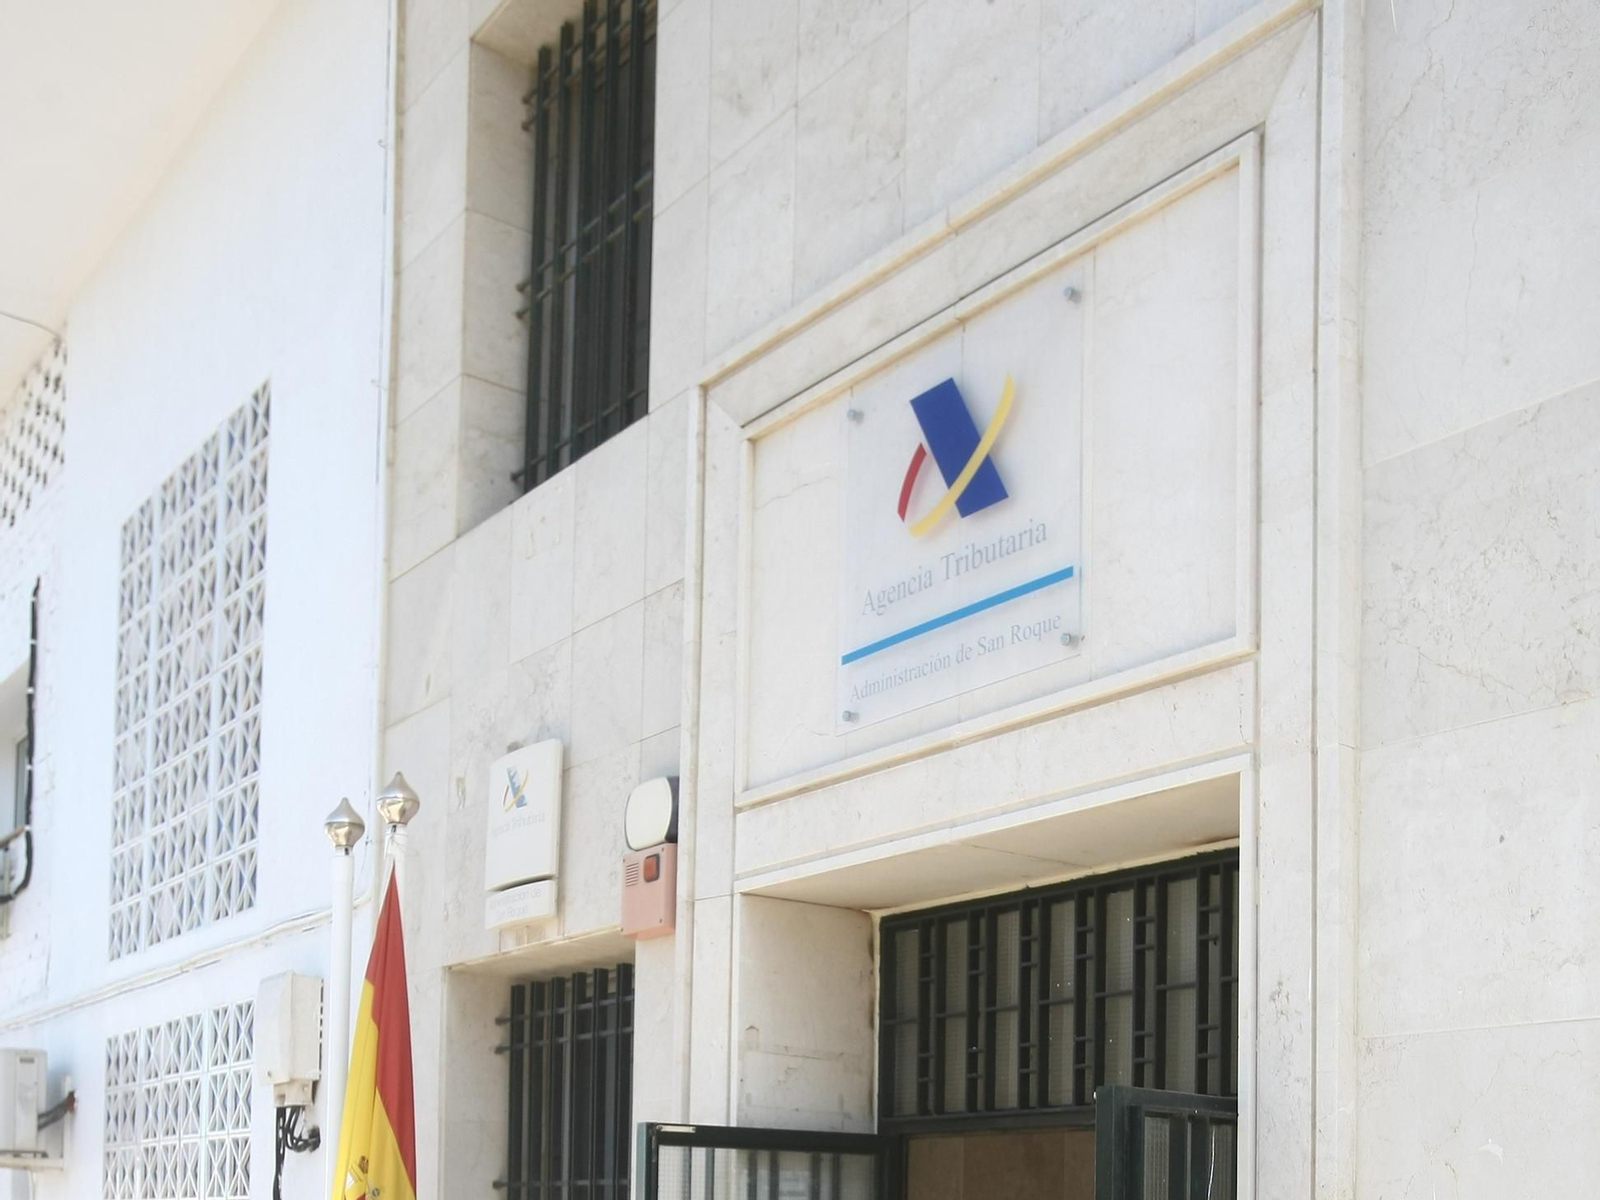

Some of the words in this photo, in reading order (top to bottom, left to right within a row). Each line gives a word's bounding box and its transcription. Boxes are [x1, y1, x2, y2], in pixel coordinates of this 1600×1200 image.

[861, 566, 933, 616] Agencia
[940, 518, 1047, 581] Tributaria
[849, 651, 951, 703] Administración
[955, 643, 973, 664] de
[977, 633, 1005, 656] San
[1010, 613, 1062, 646] Roque
